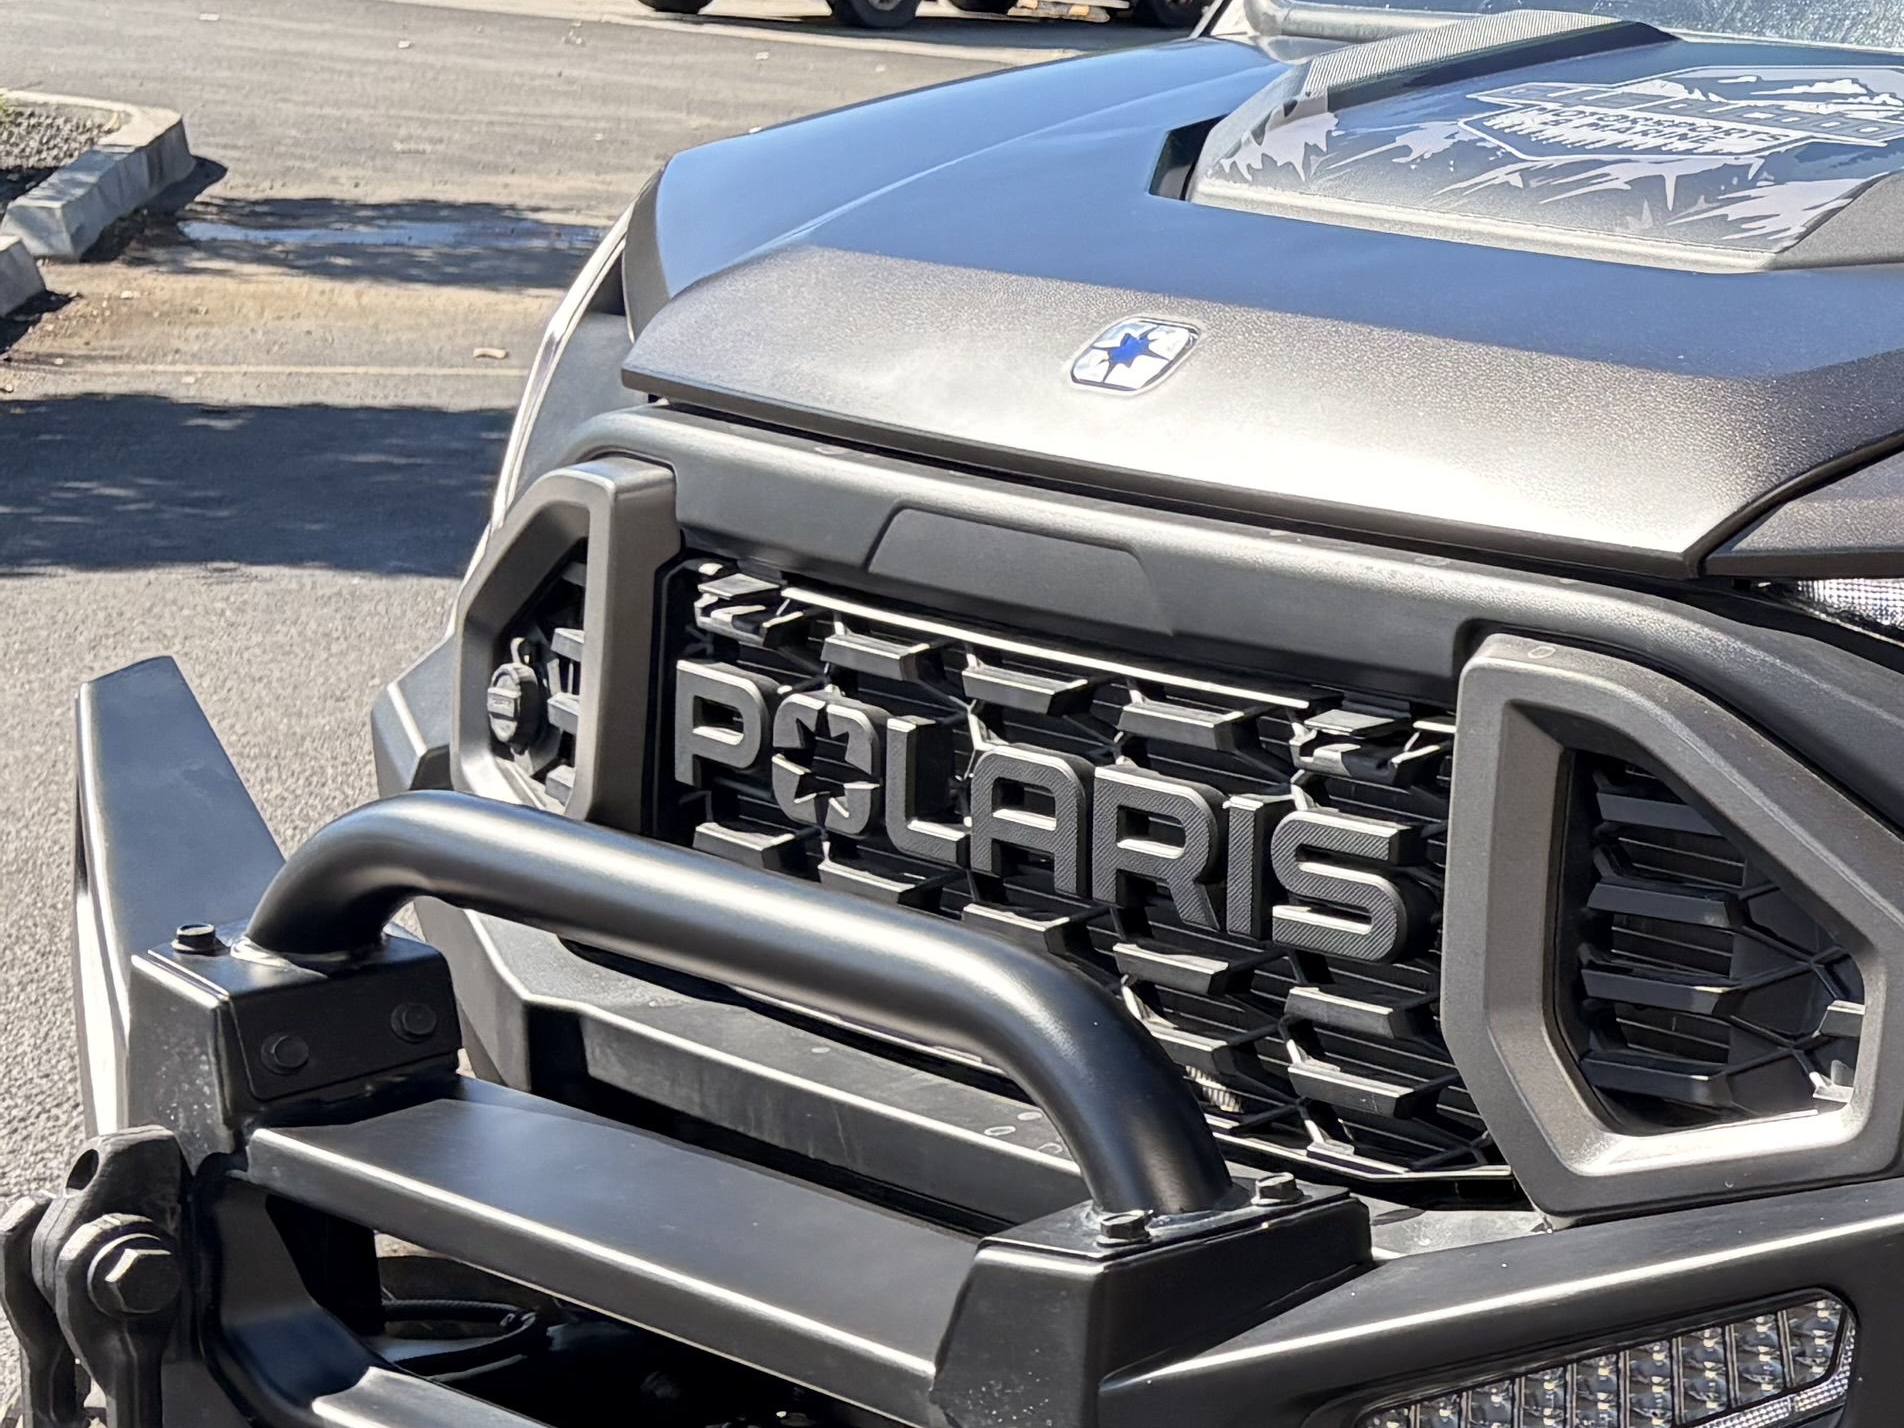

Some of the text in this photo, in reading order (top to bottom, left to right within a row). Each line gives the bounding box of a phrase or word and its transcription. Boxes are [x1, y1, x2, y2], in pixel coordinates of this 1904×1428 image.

[1529, 106, 1791, 142] MOTORSPORTS
[1570, 121, 1728, 145] MARINE
[673, 657, 1416, 966] POLARIS
